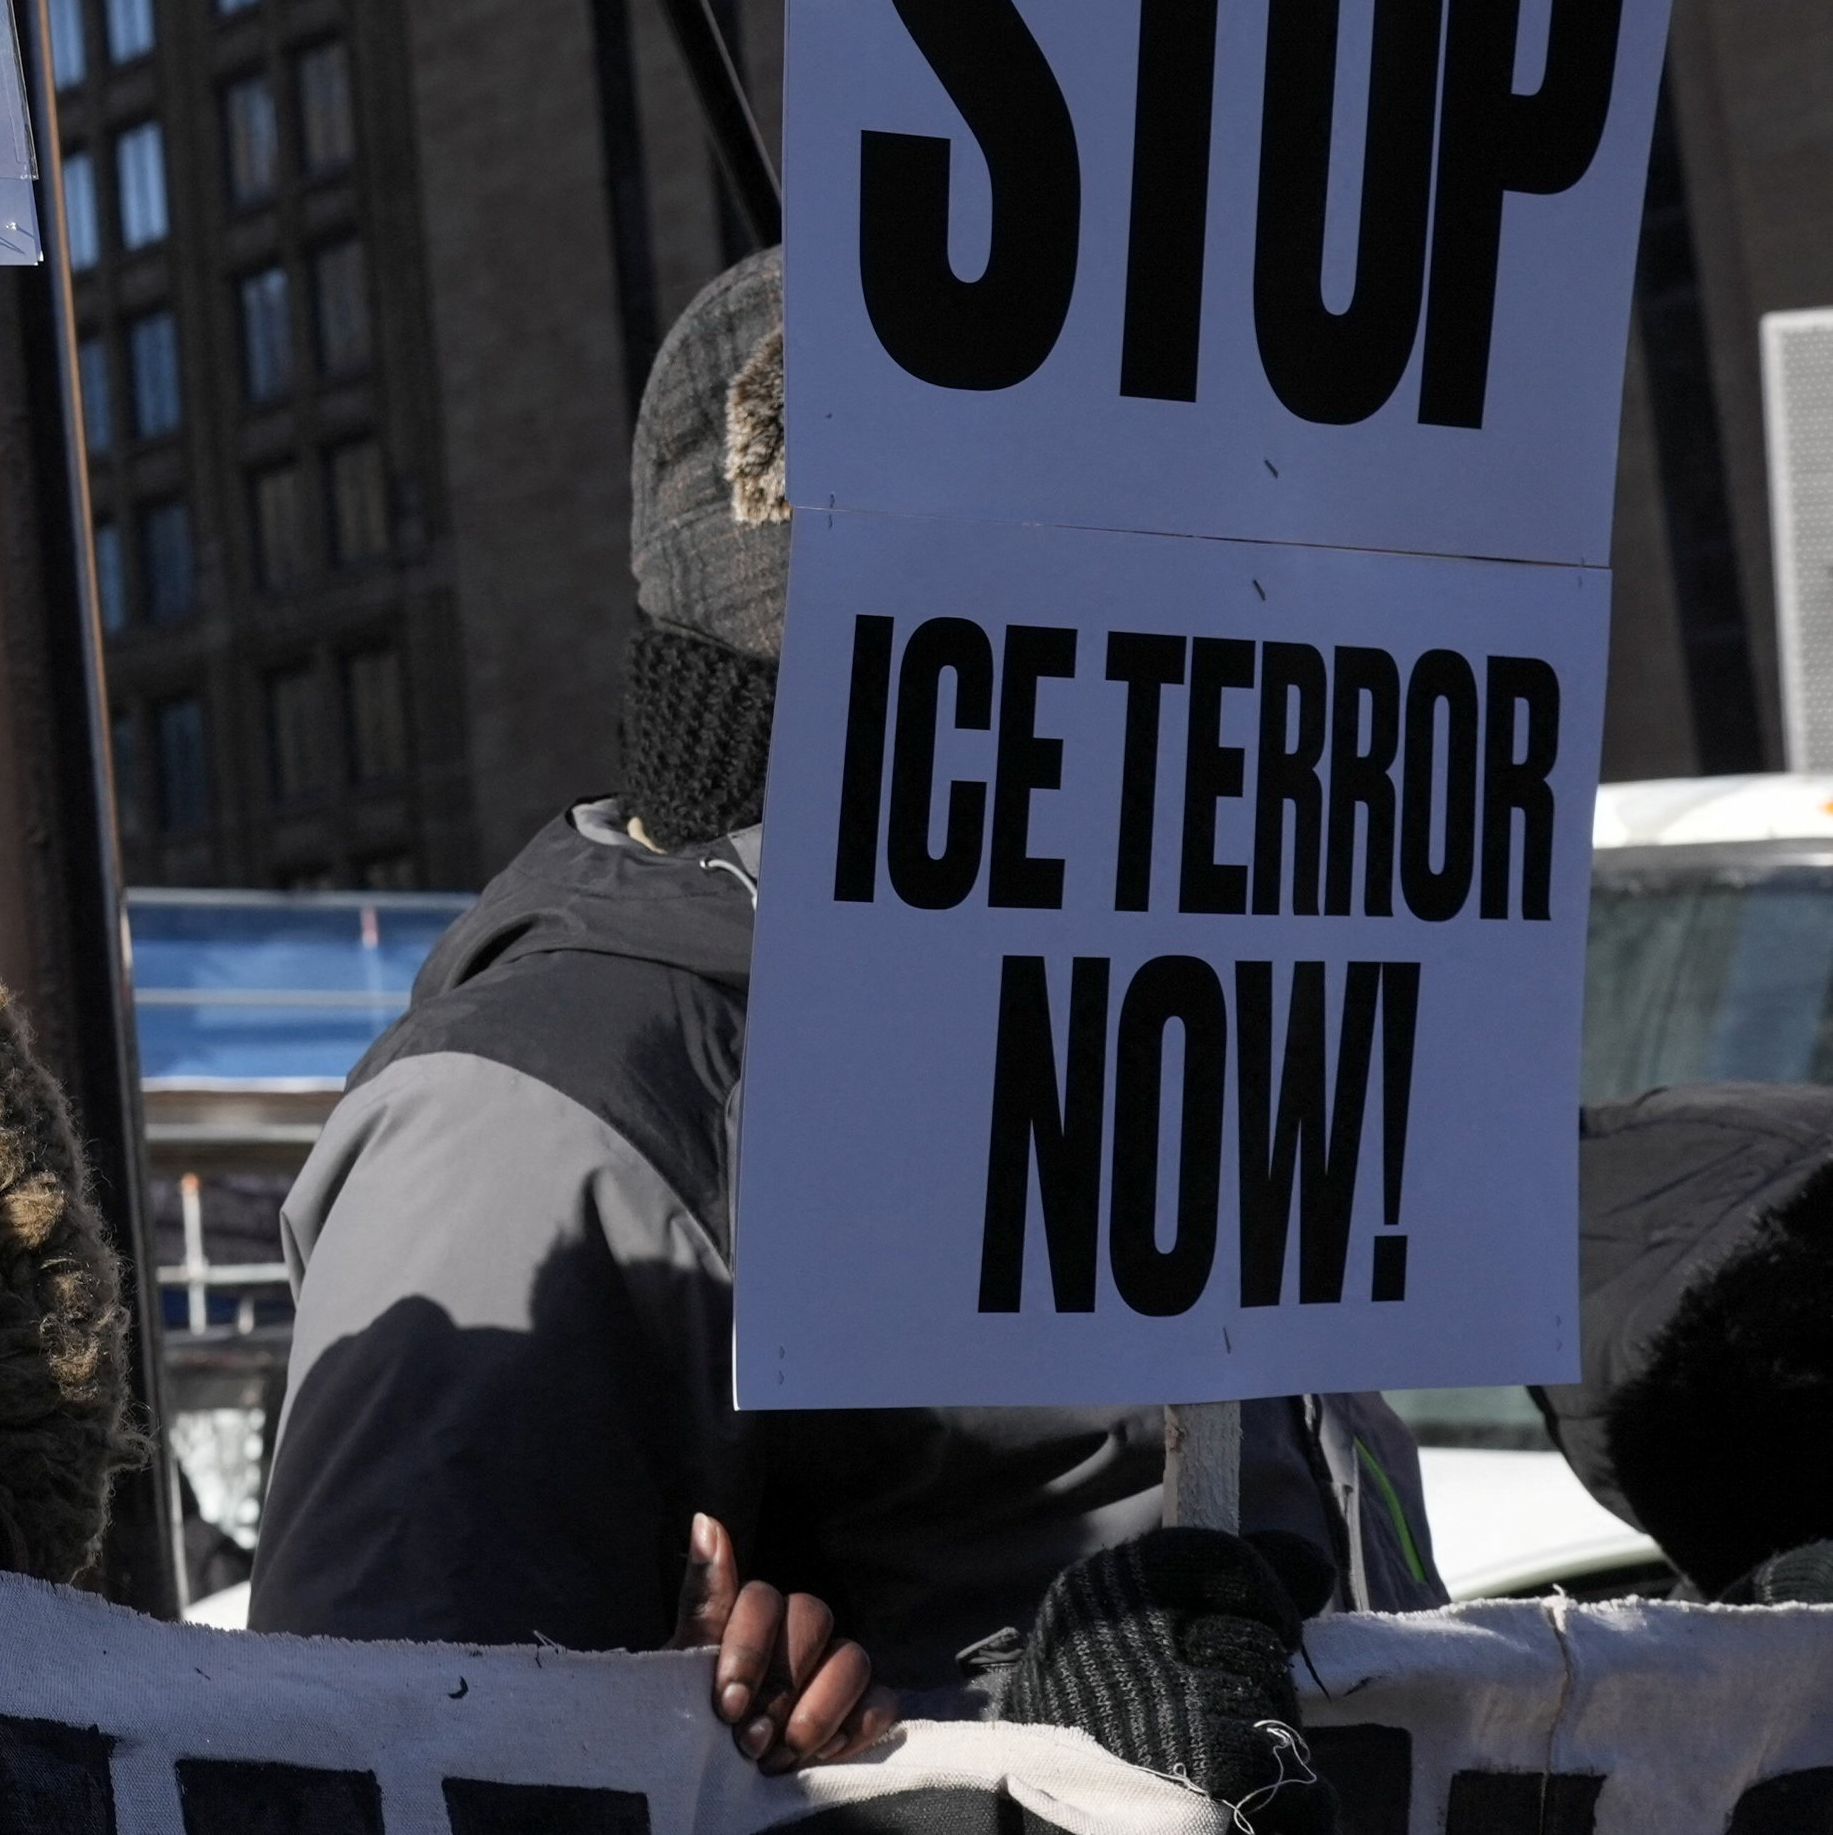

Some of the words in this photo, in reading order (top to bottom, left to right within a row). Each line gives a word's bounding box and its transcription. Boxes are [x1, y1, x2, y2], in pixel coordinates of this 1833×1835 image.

[833, 614, 1078, 910] ICE
[1104, 630, 1561, 922] TERROR
[978, 954, 1422, 1317] NOW!
